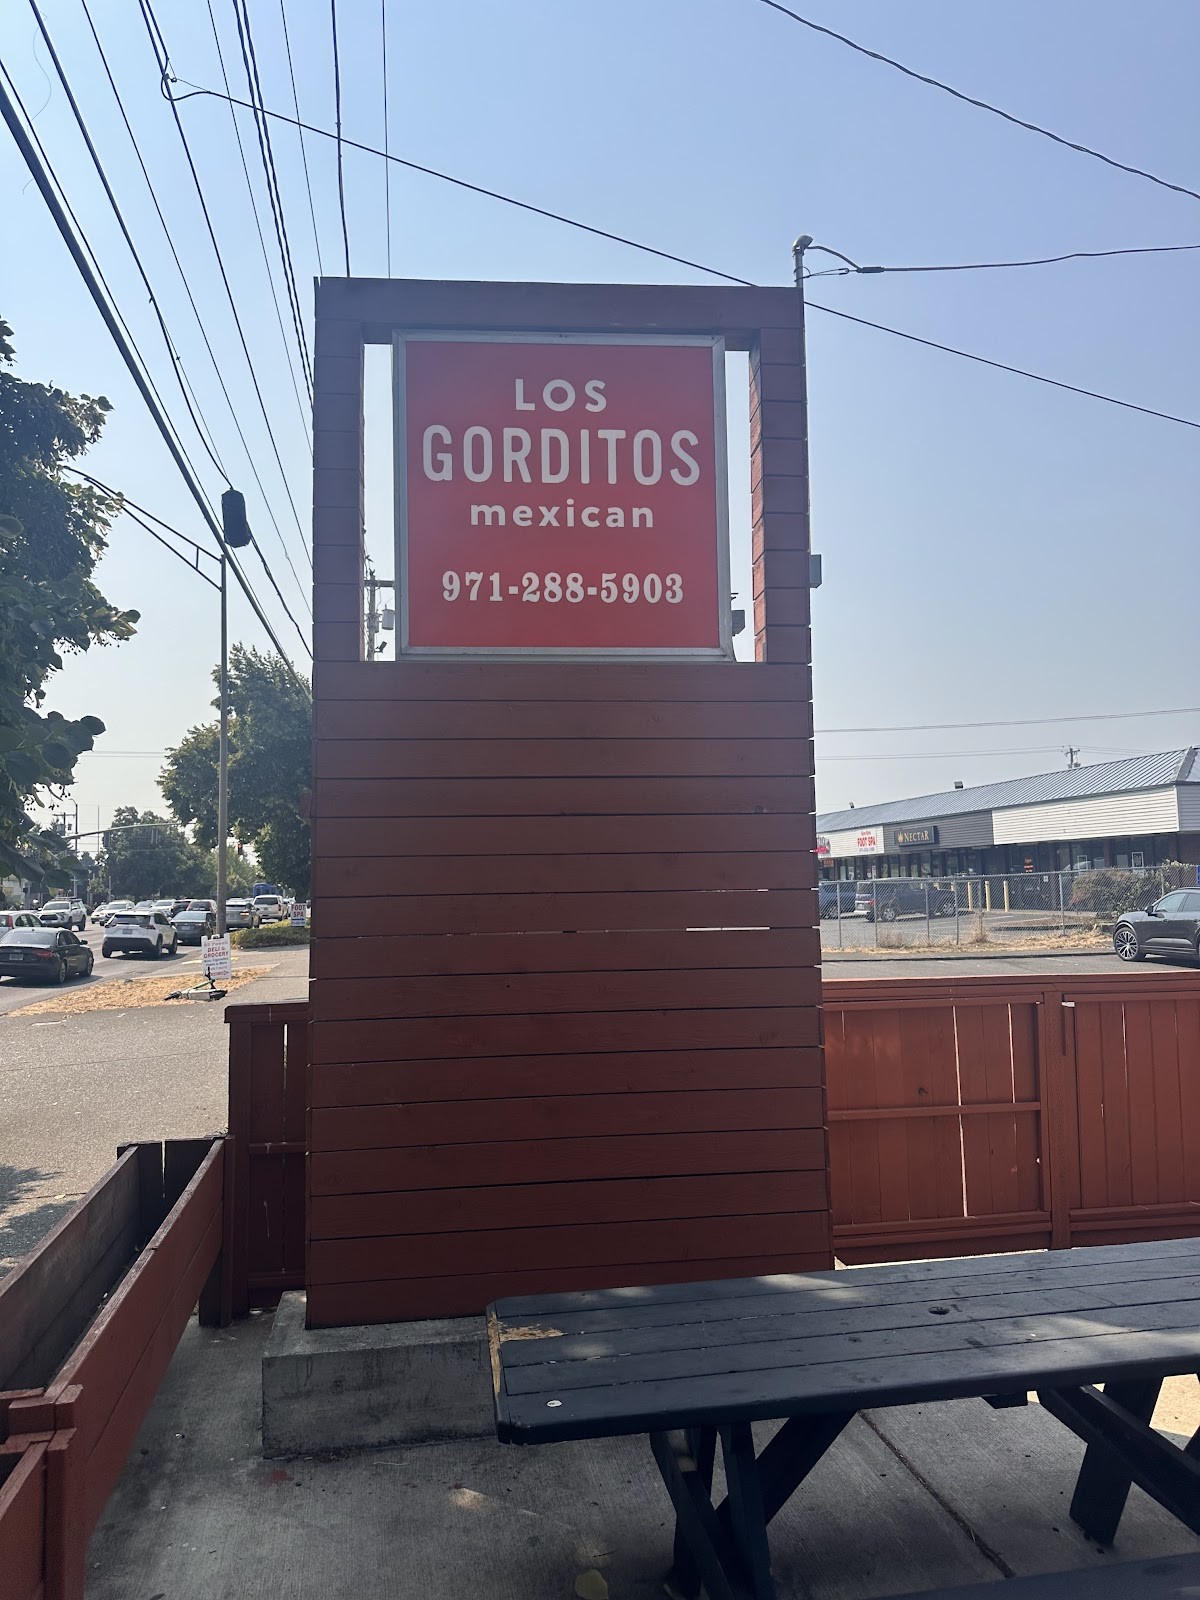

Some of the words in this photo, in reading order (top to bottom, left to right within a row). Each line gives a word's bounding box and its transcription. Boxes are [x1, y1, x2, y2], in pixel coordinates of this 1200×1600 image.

[515, 378, 607, 413] LOS
[422, 424, 701, 486] GORDITOS
[470, 498, 654, 528] mexican
[441, 570, 684, 604] 971-288-5903
[857, 837, 867, 848] FOOT
[868, 836, 876, 846] SPA
[904, 830, 929, 842] NECTAR
